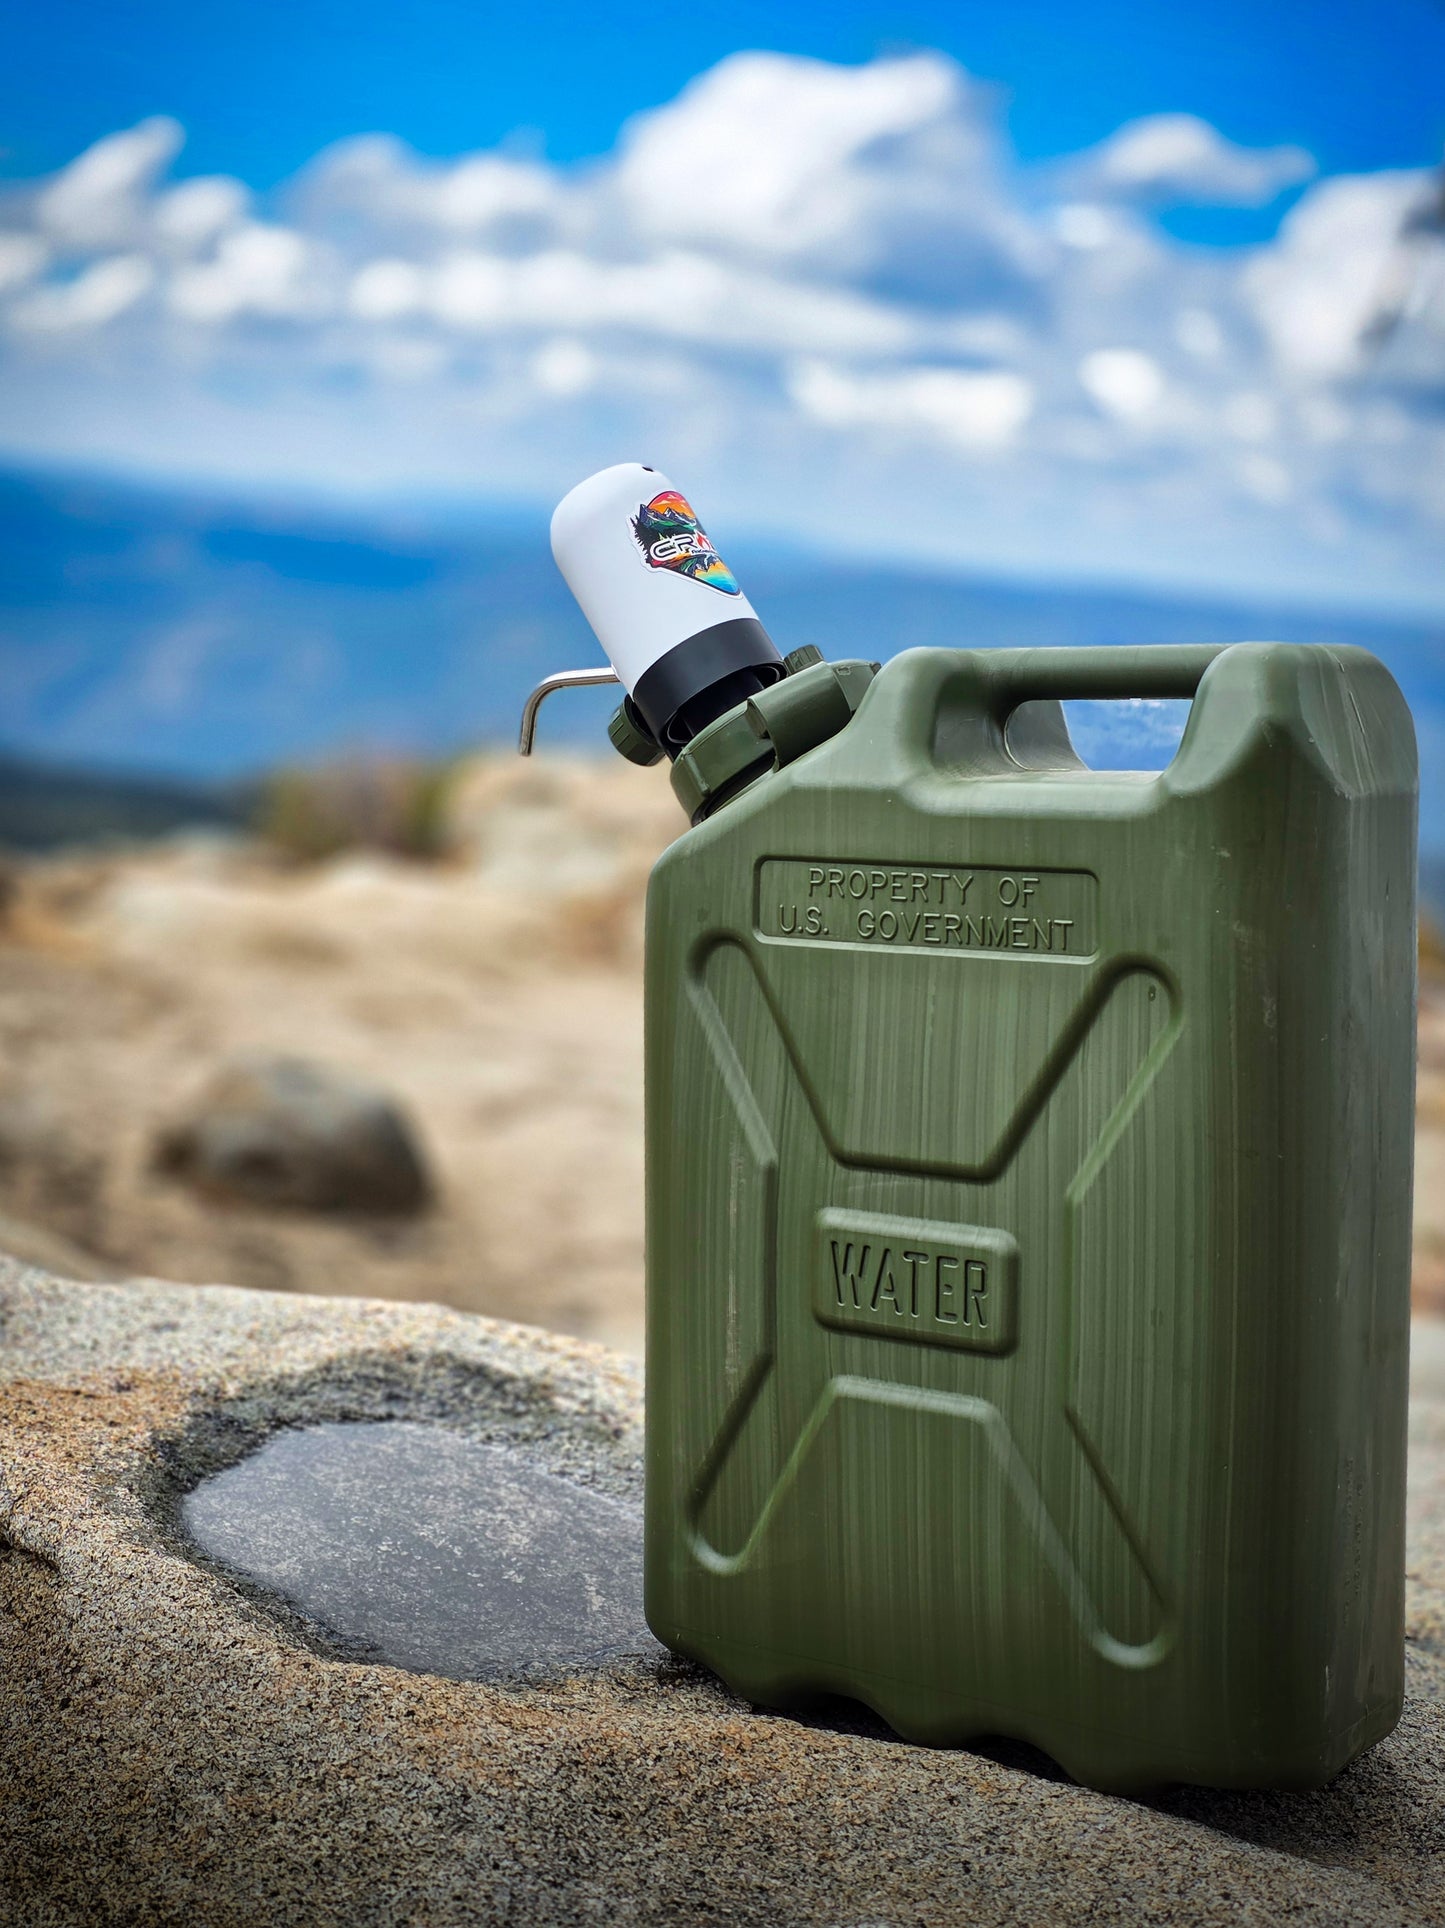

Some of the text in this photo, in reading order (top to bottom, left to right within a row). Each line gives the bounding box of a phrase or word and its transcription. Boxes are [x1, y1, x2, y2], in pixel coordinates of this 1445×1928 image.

[809, 868, 1039, 907] PROPERTY OF
[779, 904, 1074, 950] U.S. GOVERNMENT
[830, 1240, 989, 1328] WATER
